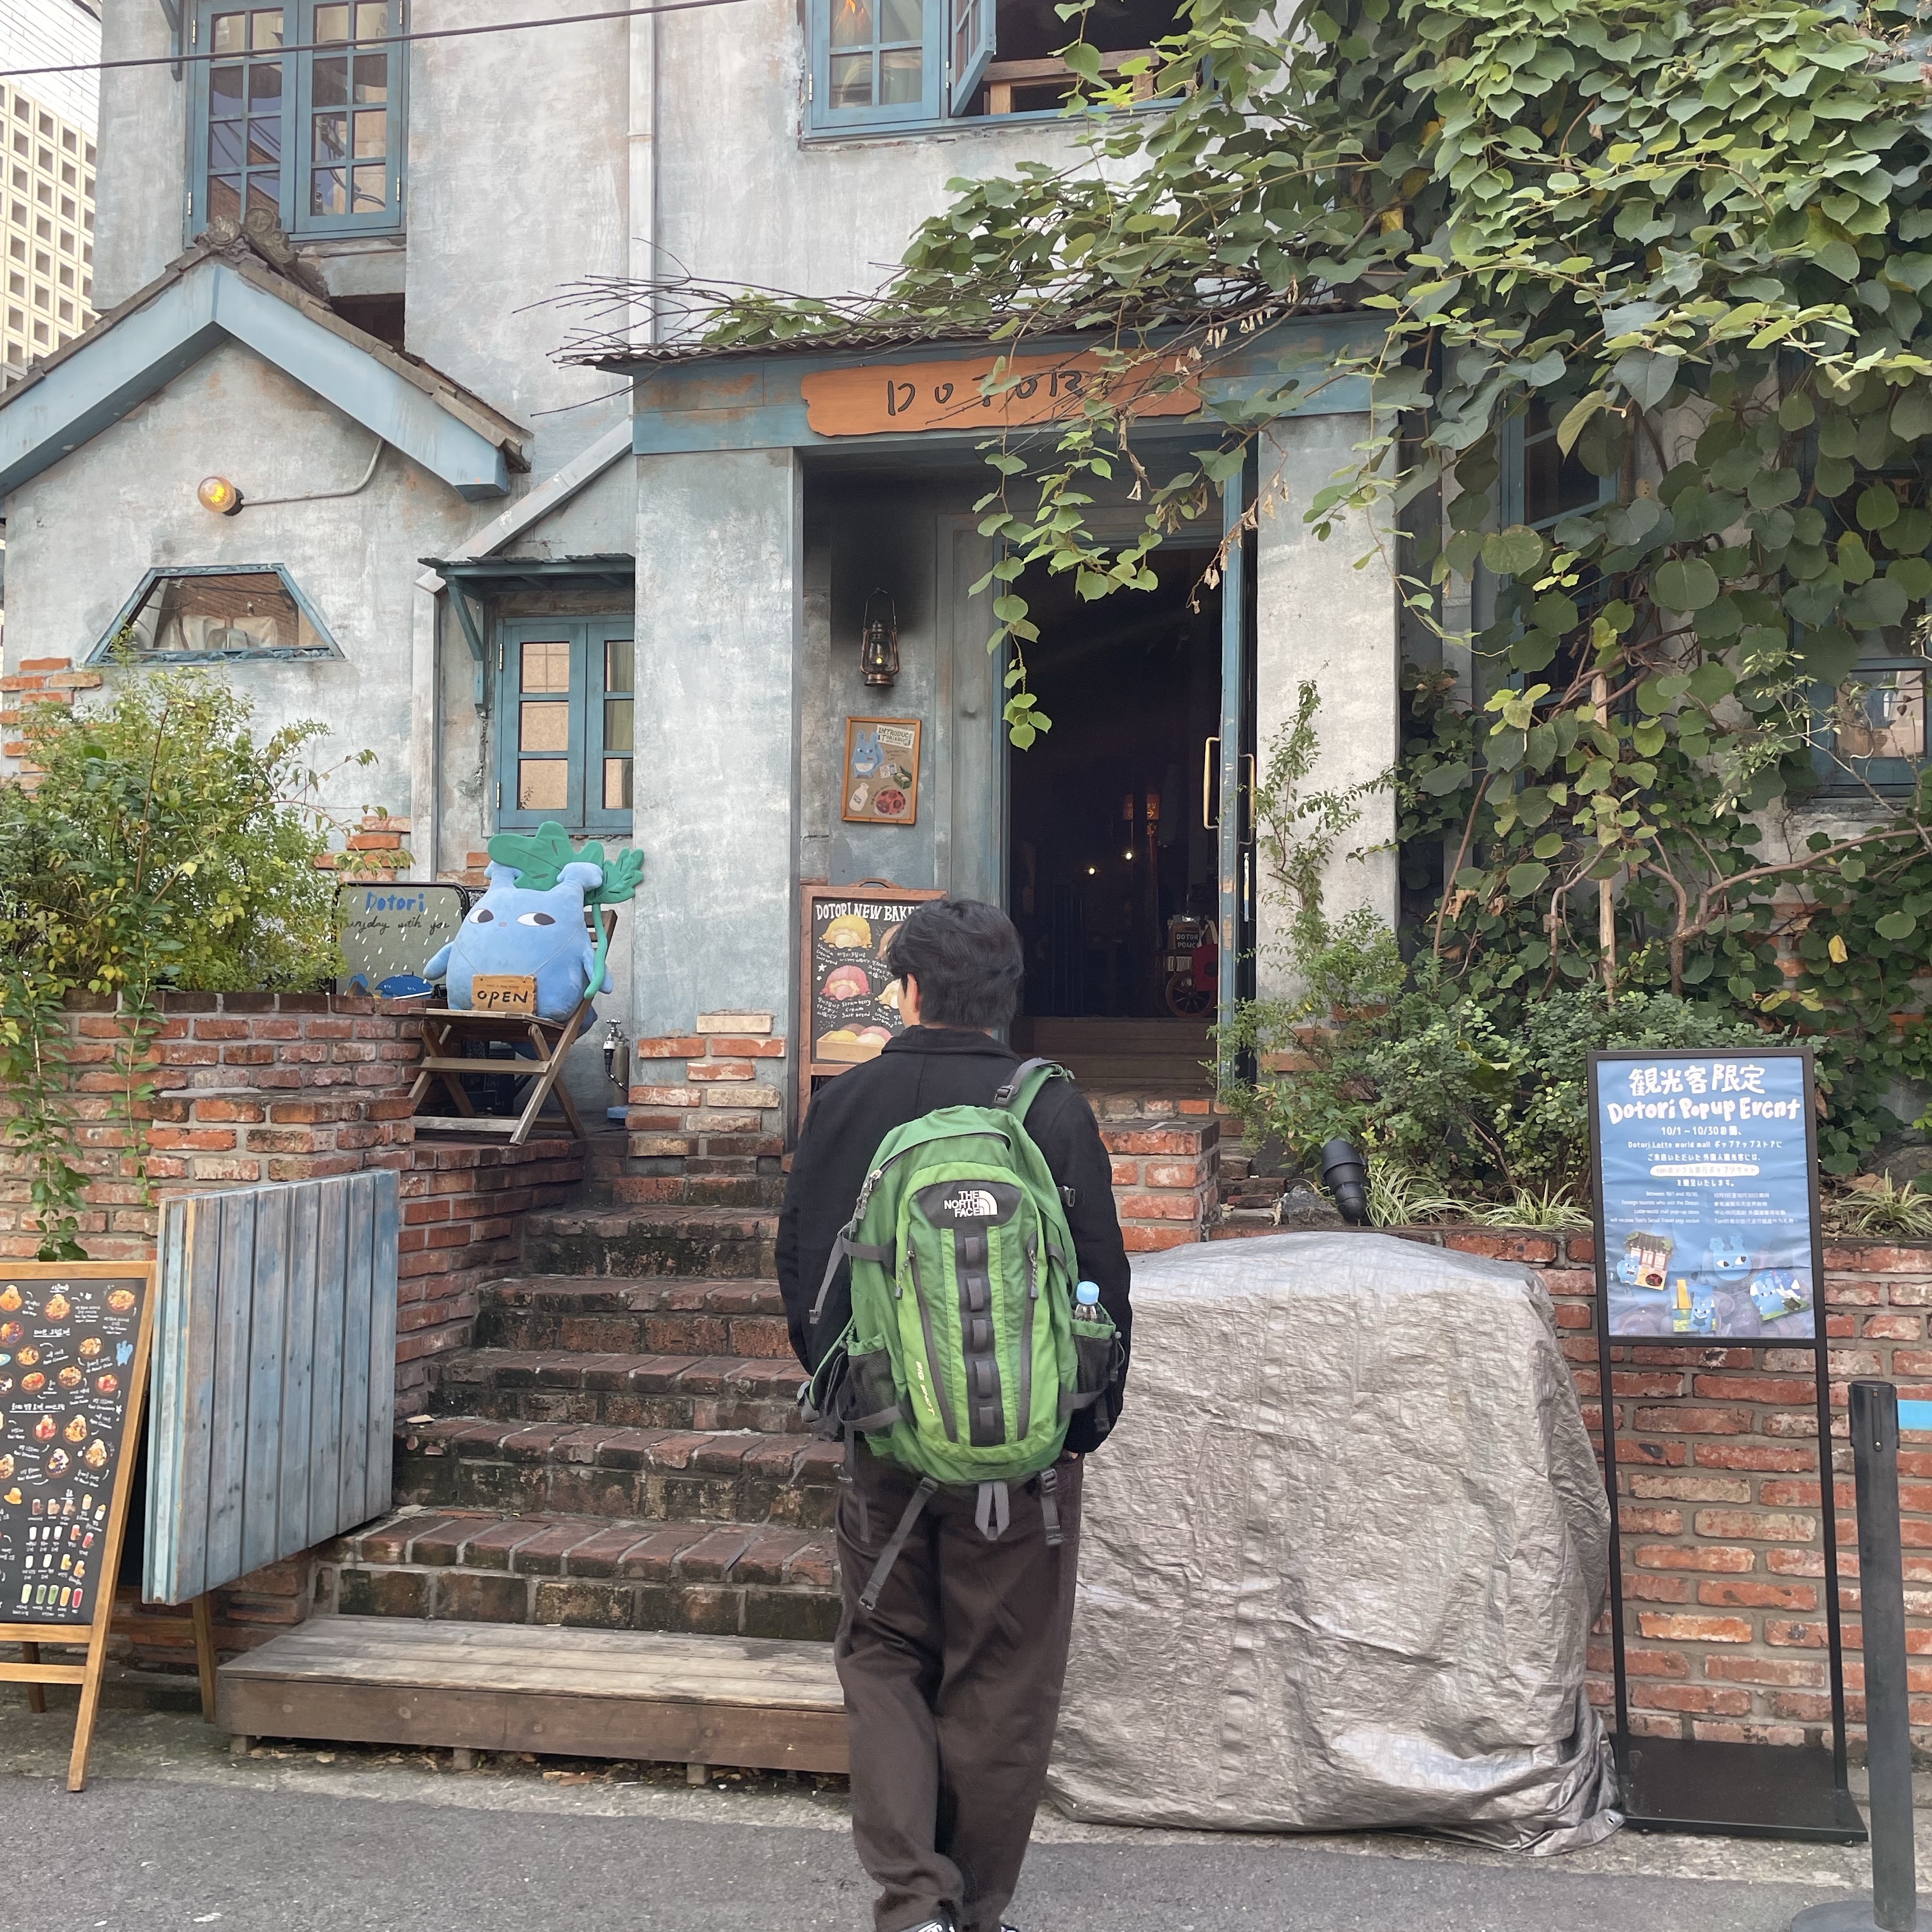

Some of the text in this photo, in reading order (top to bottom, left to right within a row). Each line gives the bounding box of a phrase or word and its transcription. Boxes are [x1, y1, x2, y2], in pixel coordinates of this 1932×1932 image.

[878, 727, 913, 739] INTRODUCE
[365, 891, 424, 912] Dotori
[815, 901, 853, 921] DOTORI
[854, 903, 883, 920] NEW
[477, 990, 528, 1008] OPEN
[1629, 1064, 1765, 1097] 観光客限定
[1607, 1096, 1801, 1124] Dotori Popup Event
[1662, 1126, 1681, 1135] 10/1
[958, 1190, 979, 1200] THE
[944, 1199, 979, 1210] NORTH
[954, 1208, 980, 1218] FACE
